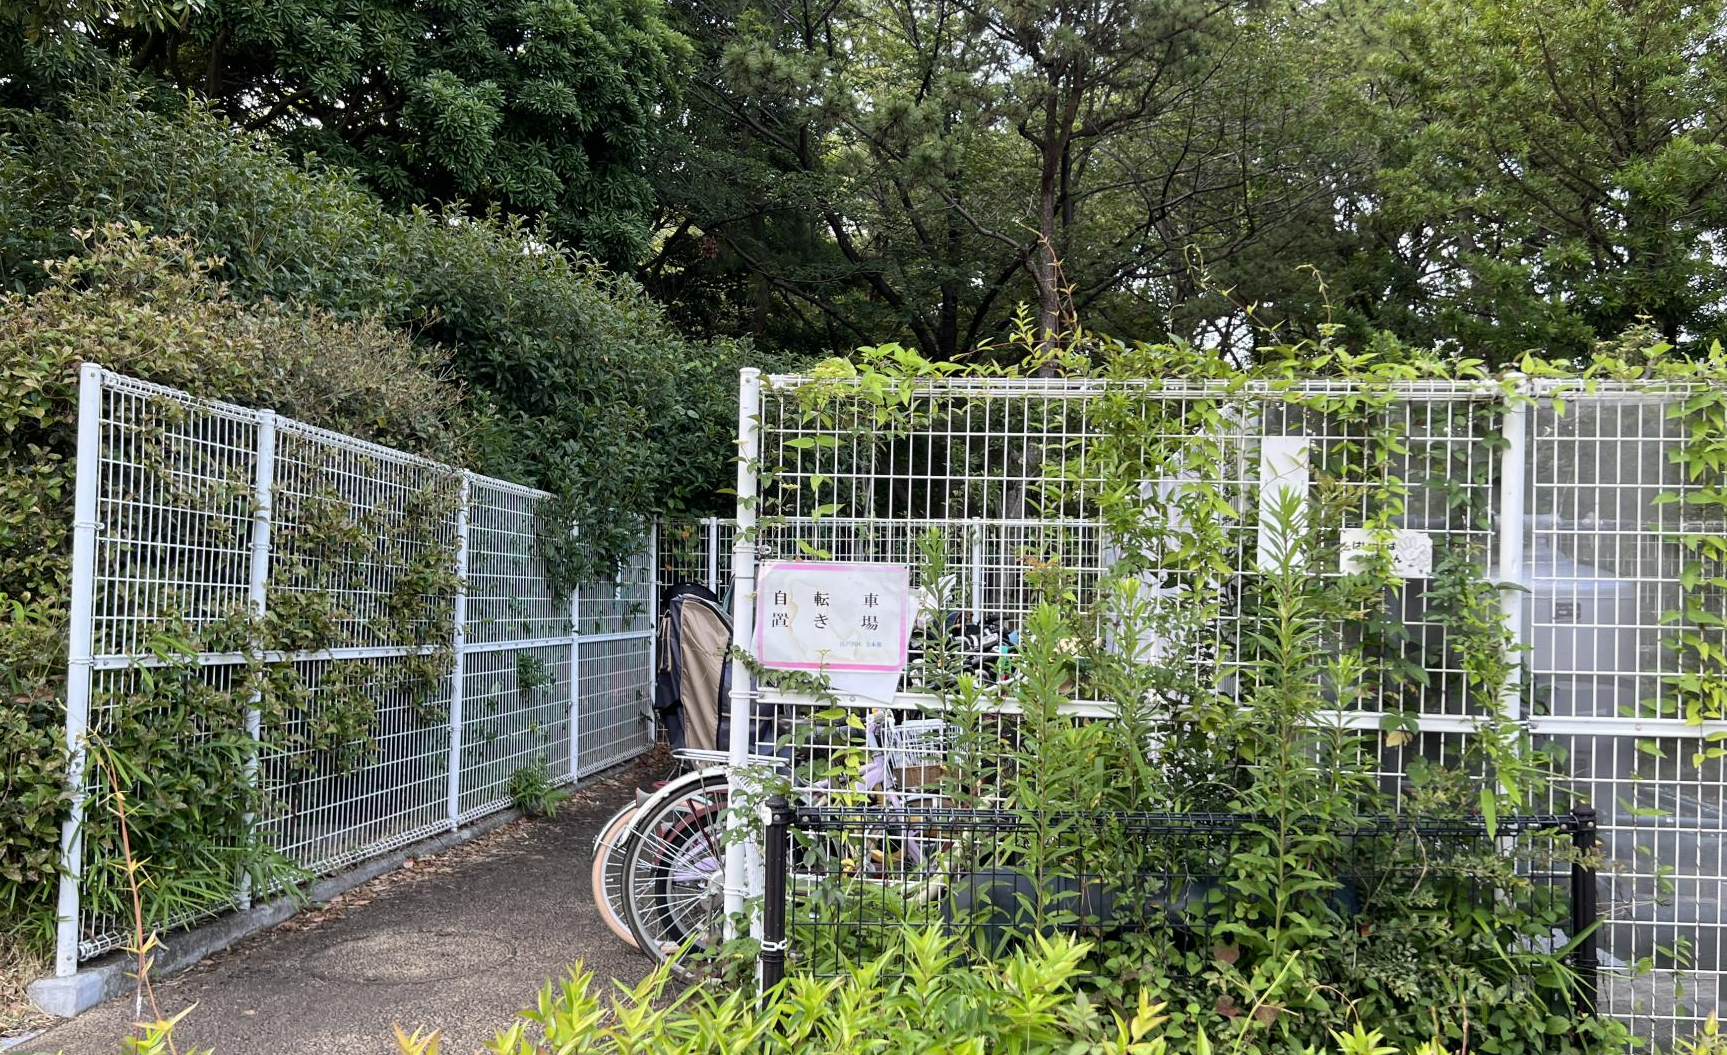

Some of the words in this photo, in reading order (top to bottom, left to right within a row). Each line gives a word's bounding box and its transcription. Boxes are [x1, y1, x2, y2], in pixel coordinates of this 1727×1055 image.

[774, 590, 879, 608] 自転車
[772, 613, 878, 631] 置き場
